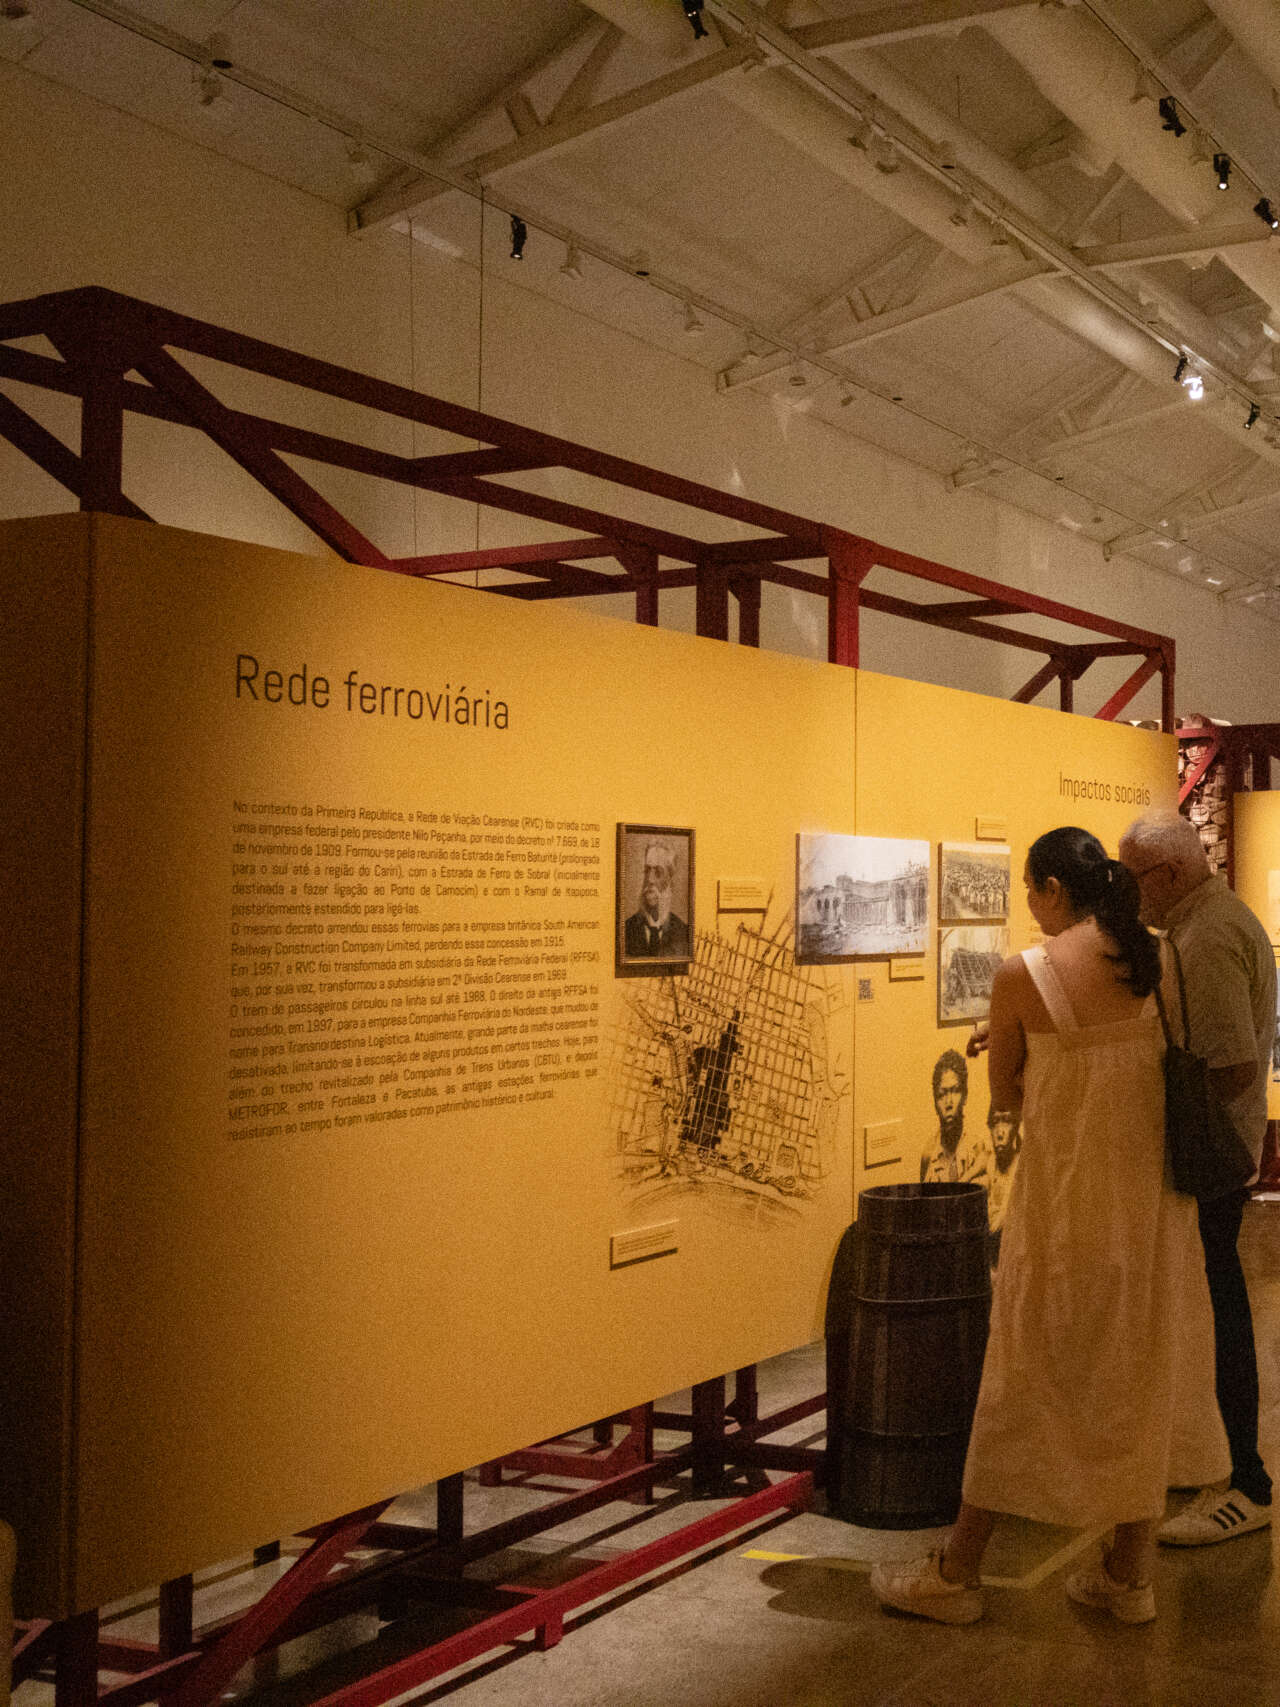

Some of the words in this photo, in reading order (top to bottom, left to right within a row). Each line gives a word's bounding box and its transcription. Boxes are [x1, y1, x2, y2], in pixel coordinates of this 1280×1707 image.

[236, 654, 330, 708] Rede
[344, 671, 509, 729] ferroviária
[1059, 771, 1111, 803] Impactos
[1115, 782, 1151, 806] sociais
[251, 801, 297, 816] contexto
[316, 805, 355, 819] Primeira
[416, 811, 437, 823] Rede
[454, 813, 480, 827] Viação
[483, 815, 519, 827] Cearense
[521, 817, 542, 830] (RVC)
[233, 824, 256, 834] uma
[259, 825, 302, 838] empresa
[305, 824, 337, 837] federal
[341, 826, 359, 840] pelo
[363, 827, 409, 842] presidente
[412, 829, 427, 841] Nilo
[470, 834, 484, 845] por
[486, 832, 503, 844] meio
[516, 834, 544, 845] decreto
[248, 842, 297, 855] novembro
[345, 845, 394, 858] Formou-se
[397, 847, 414, 861] pela
[417, 848, 447, 859] reunião
[462, 849, 492, 861] Estrada
[506, 851, 526, 862] Ferro
[232, 865, 256, 877] para
[272, 863, 287, 875] sul
[293, 863, 308, 875] até
[325, 864, 353, 878] região
[408, 868, 427, 877] com
[440, 867, 472, 878] Estrada
[490, 868, 510, 879] Ferro
[527, 869, 550, 879] Sobral
[232, 882, 283, 895] destinada
[303, 883, 327, 895] fazer
[334, 883, 367, 898] ligação
[391, 884, 414, 895] Porto
[436, 885, 478, 898] Camocim)
[493, 888, 509, 896] com
[524, 886, 547, 896] Ramal
[232, 902, 311, 917] posteriormente
[314, 903, 360, 914] estendido
[364, 905, 383, 916] para
[243, 925, 281, 935] mesmo
[285, 922, 323, 934] decreto
[327, 922, 368, 934] arrendou
[371, 924, 398, 933] essas
[402, 921, 439, 932] ferrovias
[442, 923, 459, 934] para
[471, 923, 505, 934] empresa
[508, 920, 540, 931] britânica
[232, 943, 271, 958] Railway
[275, 941, 338, 954] Construction
[342, 940, 383, 955] Company
[424, 939, 462, 953] perdendo
[465, 941, 484, 949] essa
[486, 937, 527, 949] concessão
[295, 961, 315, 973] RVC
[319, 960, 331, 972] foi
[334, 958, 395, 971] transformada
[416, 956, 460, 968] subsidiária
[476, 954, 496, 966] Rede
[499, 953, 538, 965] Ferroviária
[255, 985, 271, 997] por
[275, 984, 292, 994] sua
[319, 977, 376, 992] transformou
[387, 975, 435, 988] subsidiária
[464, 972, 492, 984] Divisão
[495, 970, 530, 982] Cearense
[242, 1002, 266, 1016] trem
[288, 998, 348, 1015] passageiros
[352, 996, 387, 1009] circulou
[406, 993, 425, 1006] linha
[430, 992, 442, 1004] sul
[446, 991, 459, 1003] até
[337, 1019, 358, 1032] para
[368, 1016, 406, 1029] empresa
[408, 1010, 455, 1026] Companhia
[457, 1007, 500, 1020] Ferroviária
[230, 1046, 257, 1058] nome
[262, 1044, 284, 1057] para
[288, 1035, 365, 1053] Transnordestina
[467, 1025, 494, 1040] grande
[496, 1023, 517, 1037] parte
[293, 1055, 352, 1072] limitando-se
[422, 1046, 450, 1062] alguns
[452, 1043, 488, 1059] produtos
[506, 1039, 530, 1051] certos
[229, 1084, 254, 1099] além
[281, 1078, 312, 1093] trecho
[320, 1072, 372, 1089] revitalizado
[379, 1069, 397, 1085] pela
[403, 1064, 451, 1082] Companhia
[472, 1060, 493, 1073] Trens
[498, 1056, 529, 1070] Urbanos
[298, 1096, 324, 1111] entre
[331, 1091, 376, 1107] Fortaleza
[462, 1078, 492, 1094] antigas
[497, 1073, 533, 1090] estações
[229, 1121, 281, 1140] resistiram
[300, 1115, 330, 1133] tempo
[334, 1111, 361, 1126] foram
[410, 1105, 434, 1116] como
[436, 1097, 480, 1115] patrimônio
[482, 1092, 516, 1107] histórico
